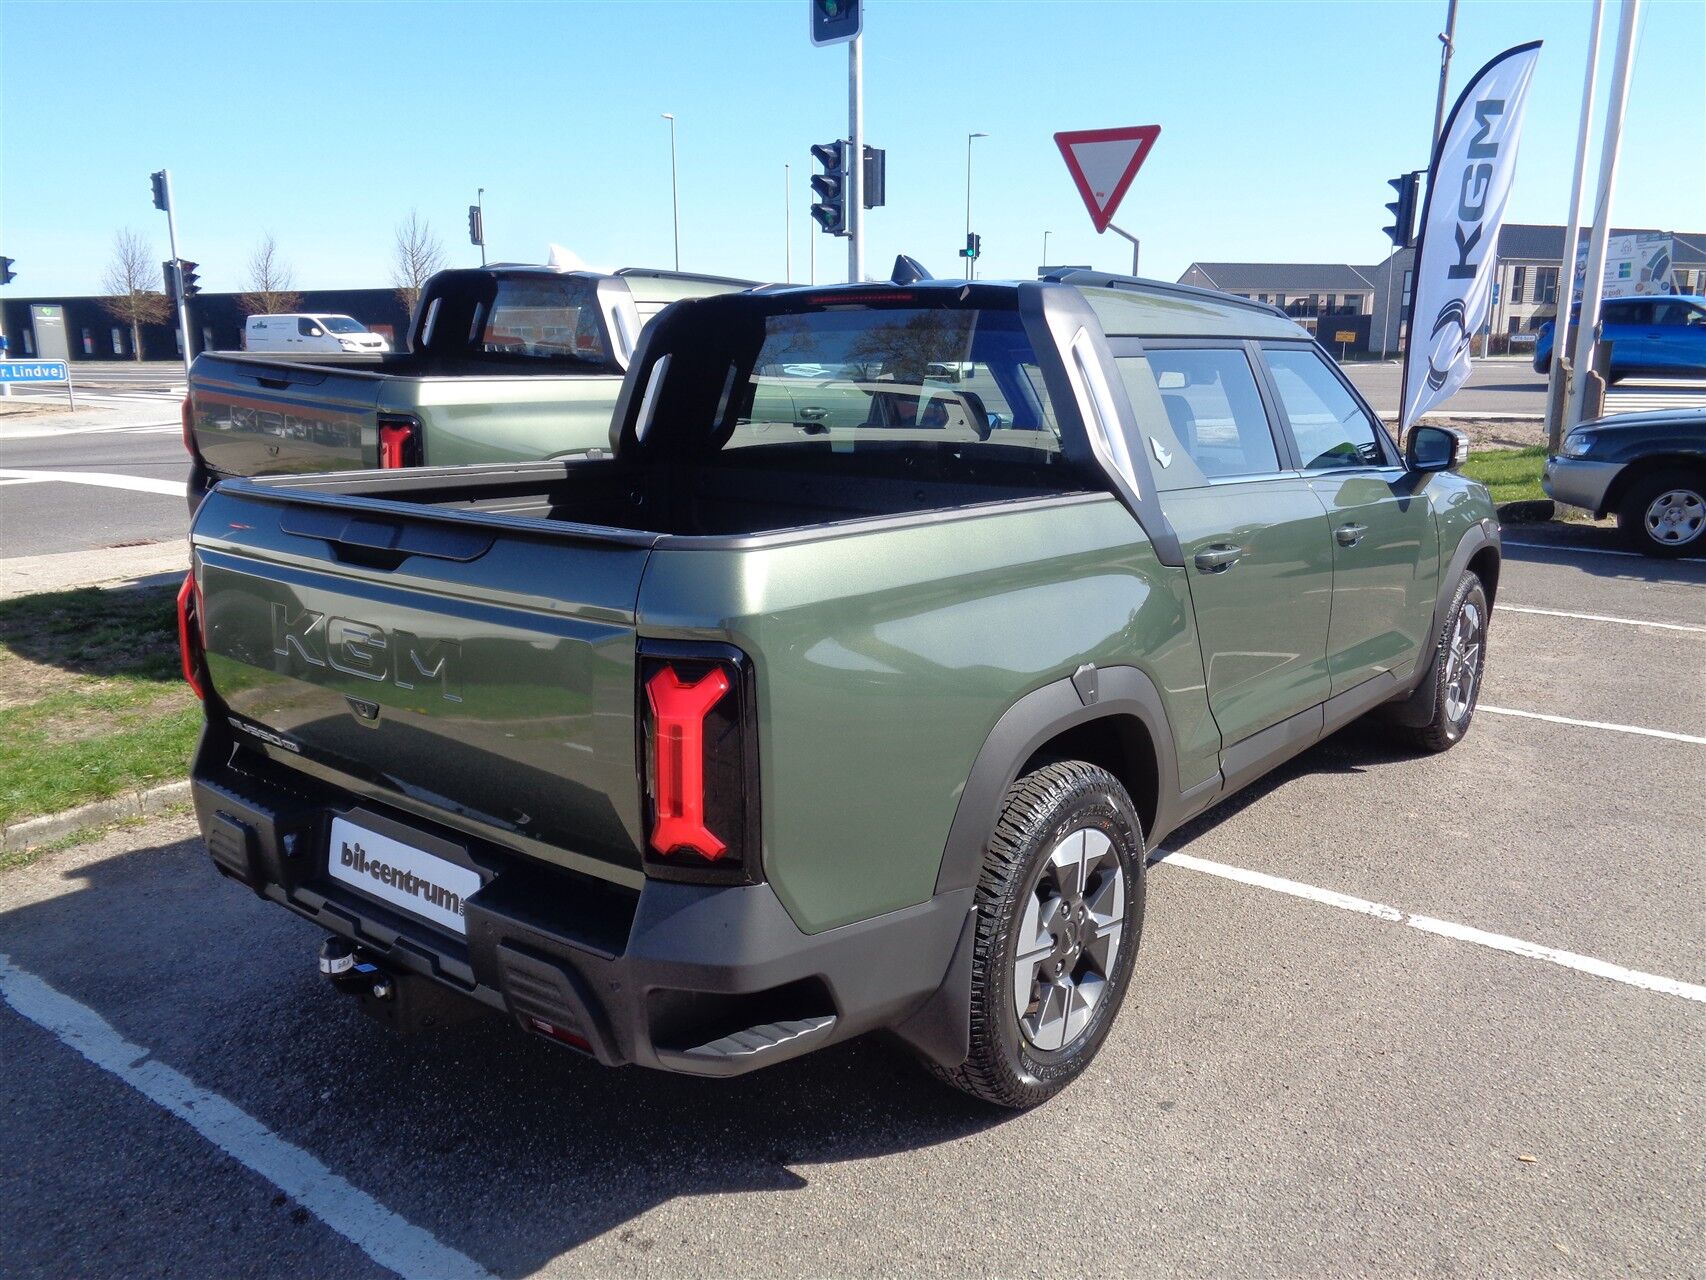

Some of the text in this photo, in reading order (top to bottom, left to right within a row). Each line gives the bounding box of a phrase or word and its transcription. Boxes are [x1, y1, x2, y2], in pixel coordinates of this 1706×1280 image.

[1447, 99, 1505, 280] KGM
[11, 365, 64, 379] Lindvej
[271, 601, 463, 703] KGM
